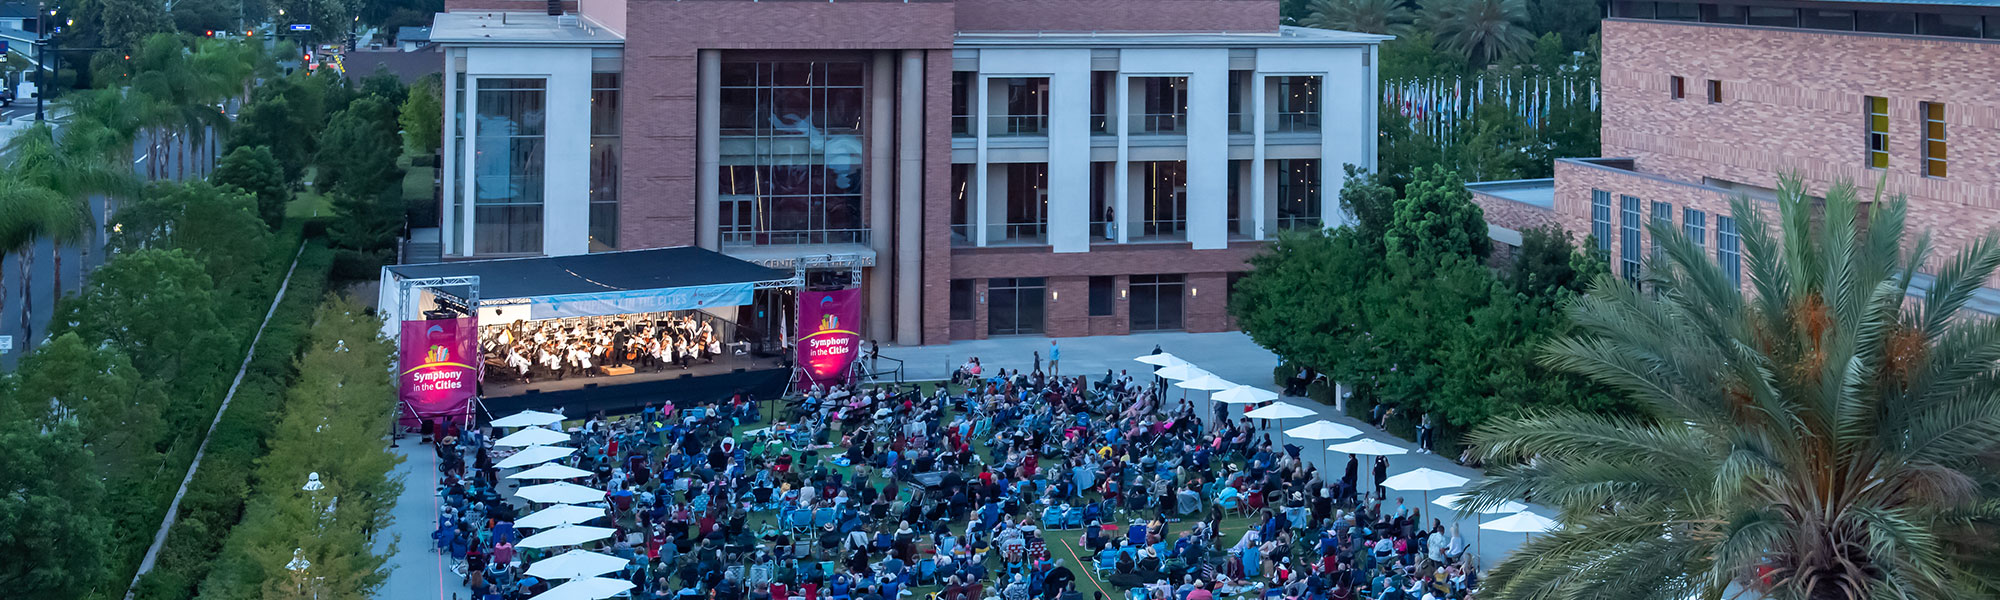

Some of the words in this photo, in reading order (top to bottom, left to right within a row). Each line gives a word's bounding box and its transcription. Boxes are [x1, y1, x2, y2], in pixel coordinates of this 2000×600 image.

[657, 293, 687, 306] CITIES
[810, 337, 849, 348] Symphony
[817, 348, 828, 356] the
[829, 346, 849, 355] Cities
[413, 371, 462, 383] Symphony
[413, 383, 421, 391] in
[421, 383, 434, 391] the
[435, 380, 462, 390] Cities
